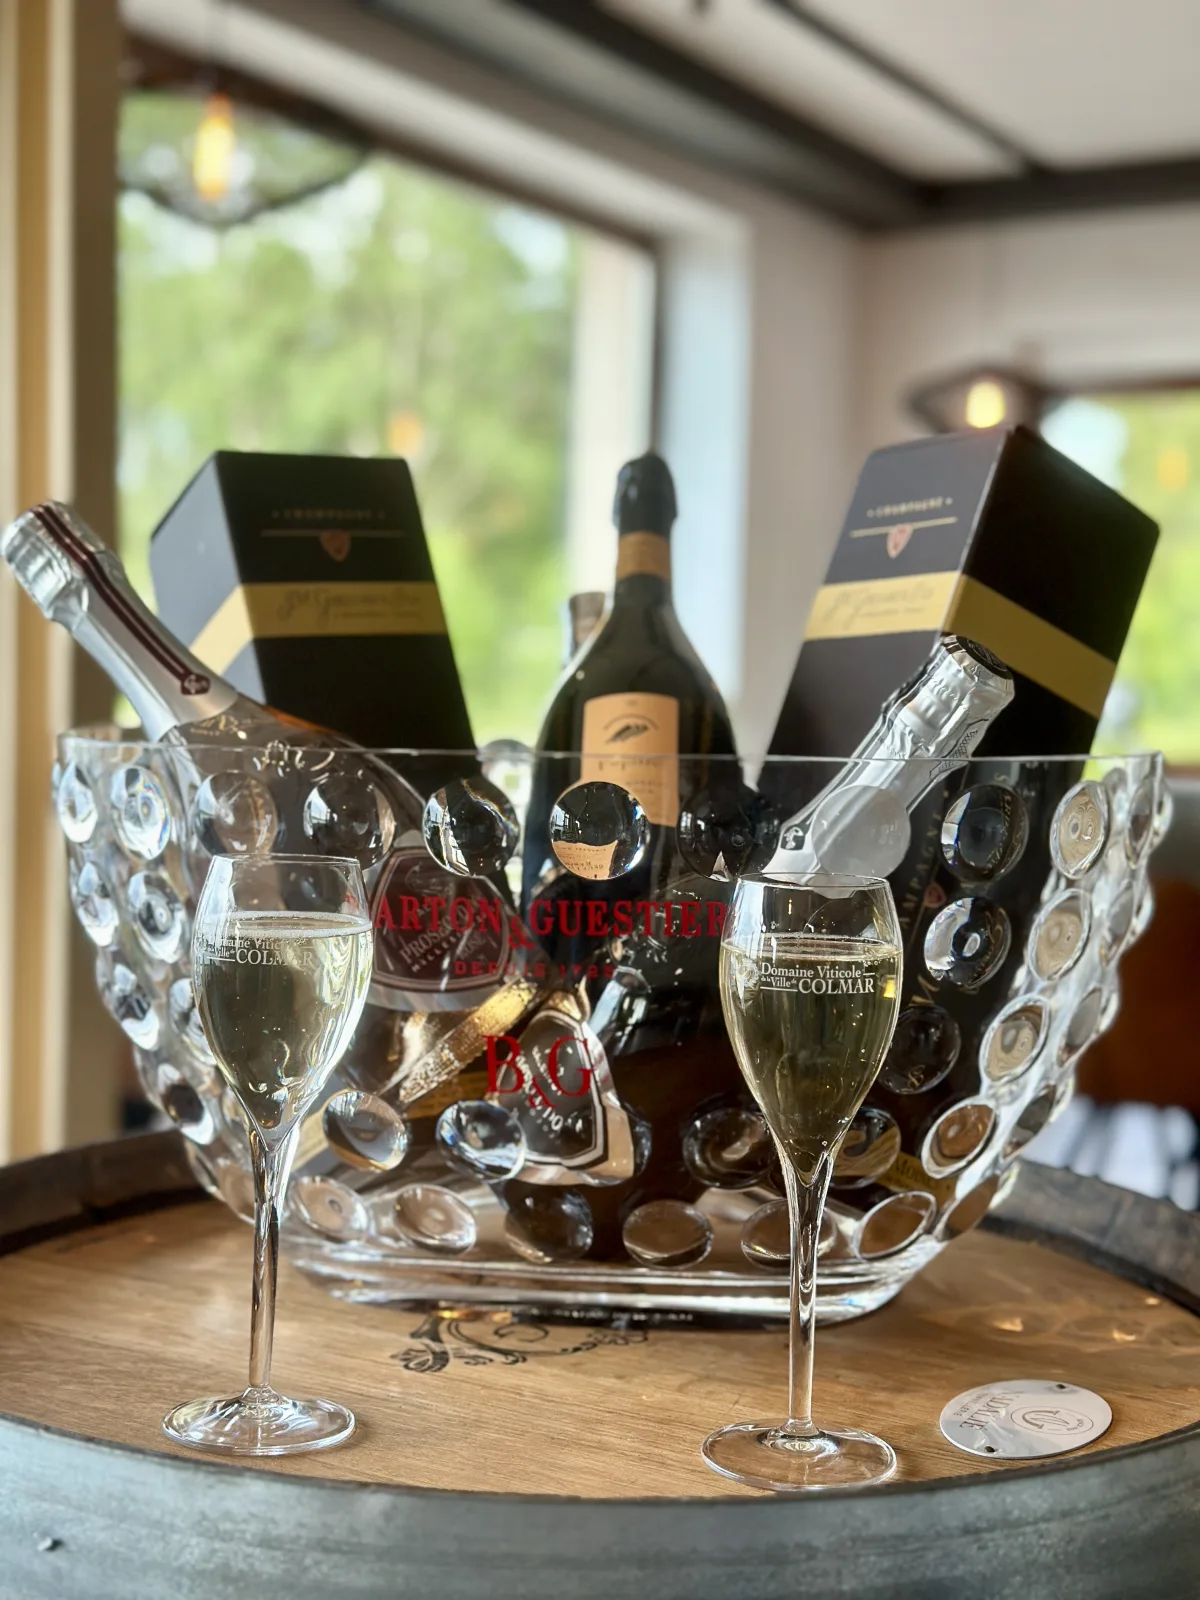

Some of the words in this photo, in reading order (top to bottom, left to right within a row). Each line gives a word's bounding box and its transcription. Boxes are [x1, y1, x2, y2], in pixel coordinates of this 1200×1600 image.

[374, 894, 503, 936] ARTON
[528, 899, 728, 938] GUESTIER
[760, 962, 815, 978] Domaine
[816, 964, 862, 979] Viticole
[771, 977, 791, 988] Ville
[798, 978, 875, 995] COLMAR
